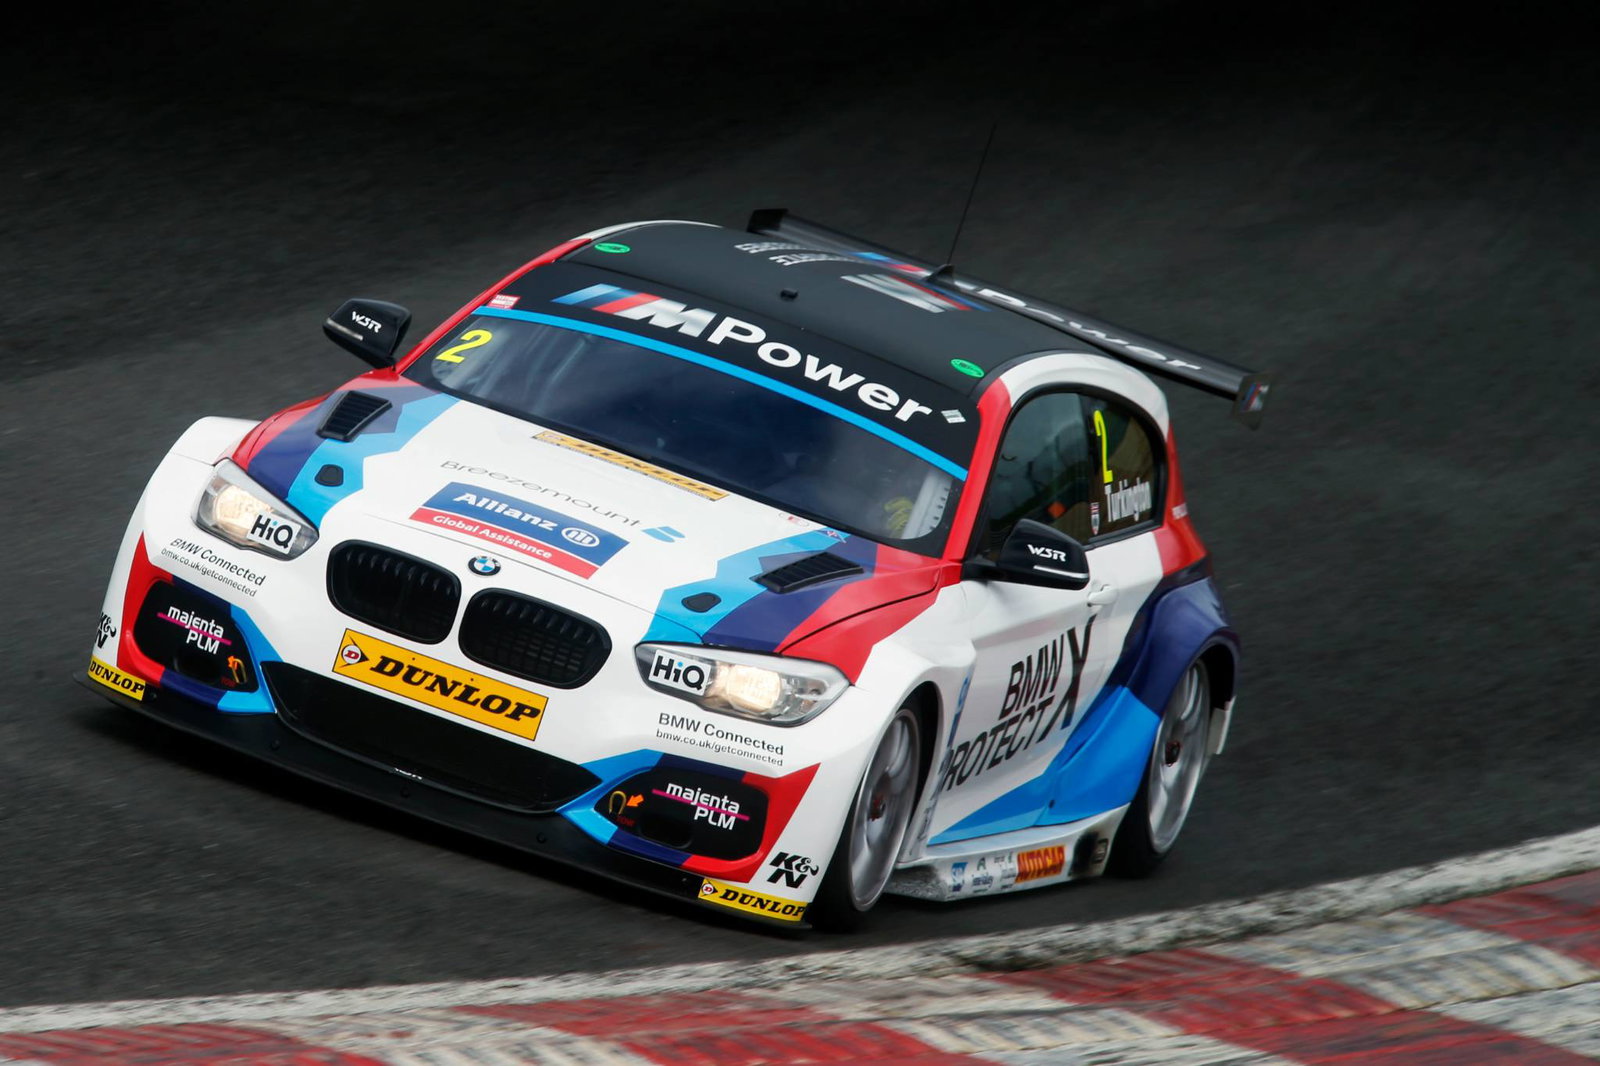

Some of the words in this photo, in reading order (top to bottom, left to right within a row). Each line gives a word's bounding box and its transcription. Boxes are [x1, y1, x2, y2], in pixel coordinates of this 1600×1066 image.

[350, 311, 382, 334] WSR
[435, 329, 493, 364] 2
[1093, 410, 1114, 484] 2
[440, 460, 643, 528] Breezemount
[453, 492, 558, 531] Allianz
[250, 514, 294, 550] HiQ
[432, 515, 479, 532] Global
[479, 529, 553, 559] Assistance
[170, 538, 202, 555] BMW
[200, 549, 266, 587] Connected
[1027, 544, 1067, 562] WSR
[161, 548, 258, 597] bmw.co.uk/getconnected
[167, 606, 224, 639] majenta
[185, 629, 220, 655] PLM
[89, 660, 145, 694] DUNLOP
[369, 655, 541, 721] DUNLOP
[652, 655, 705, 691] HiQ
[998, 633, 1065, 722] BMW
[1037, 613, 1098, 743] X
[656, 729, 784, 767] bmw.co.uk/getconnected
[658, 712, 701, 733] BMW
[703, 723, 784, 756] Connected
[665, 782, 741, 814] majenta
[694, 807, 736, 831] PLM
[766, 851, 820, 889] K&N
[719, 888, 805, 917] DUNLOP
